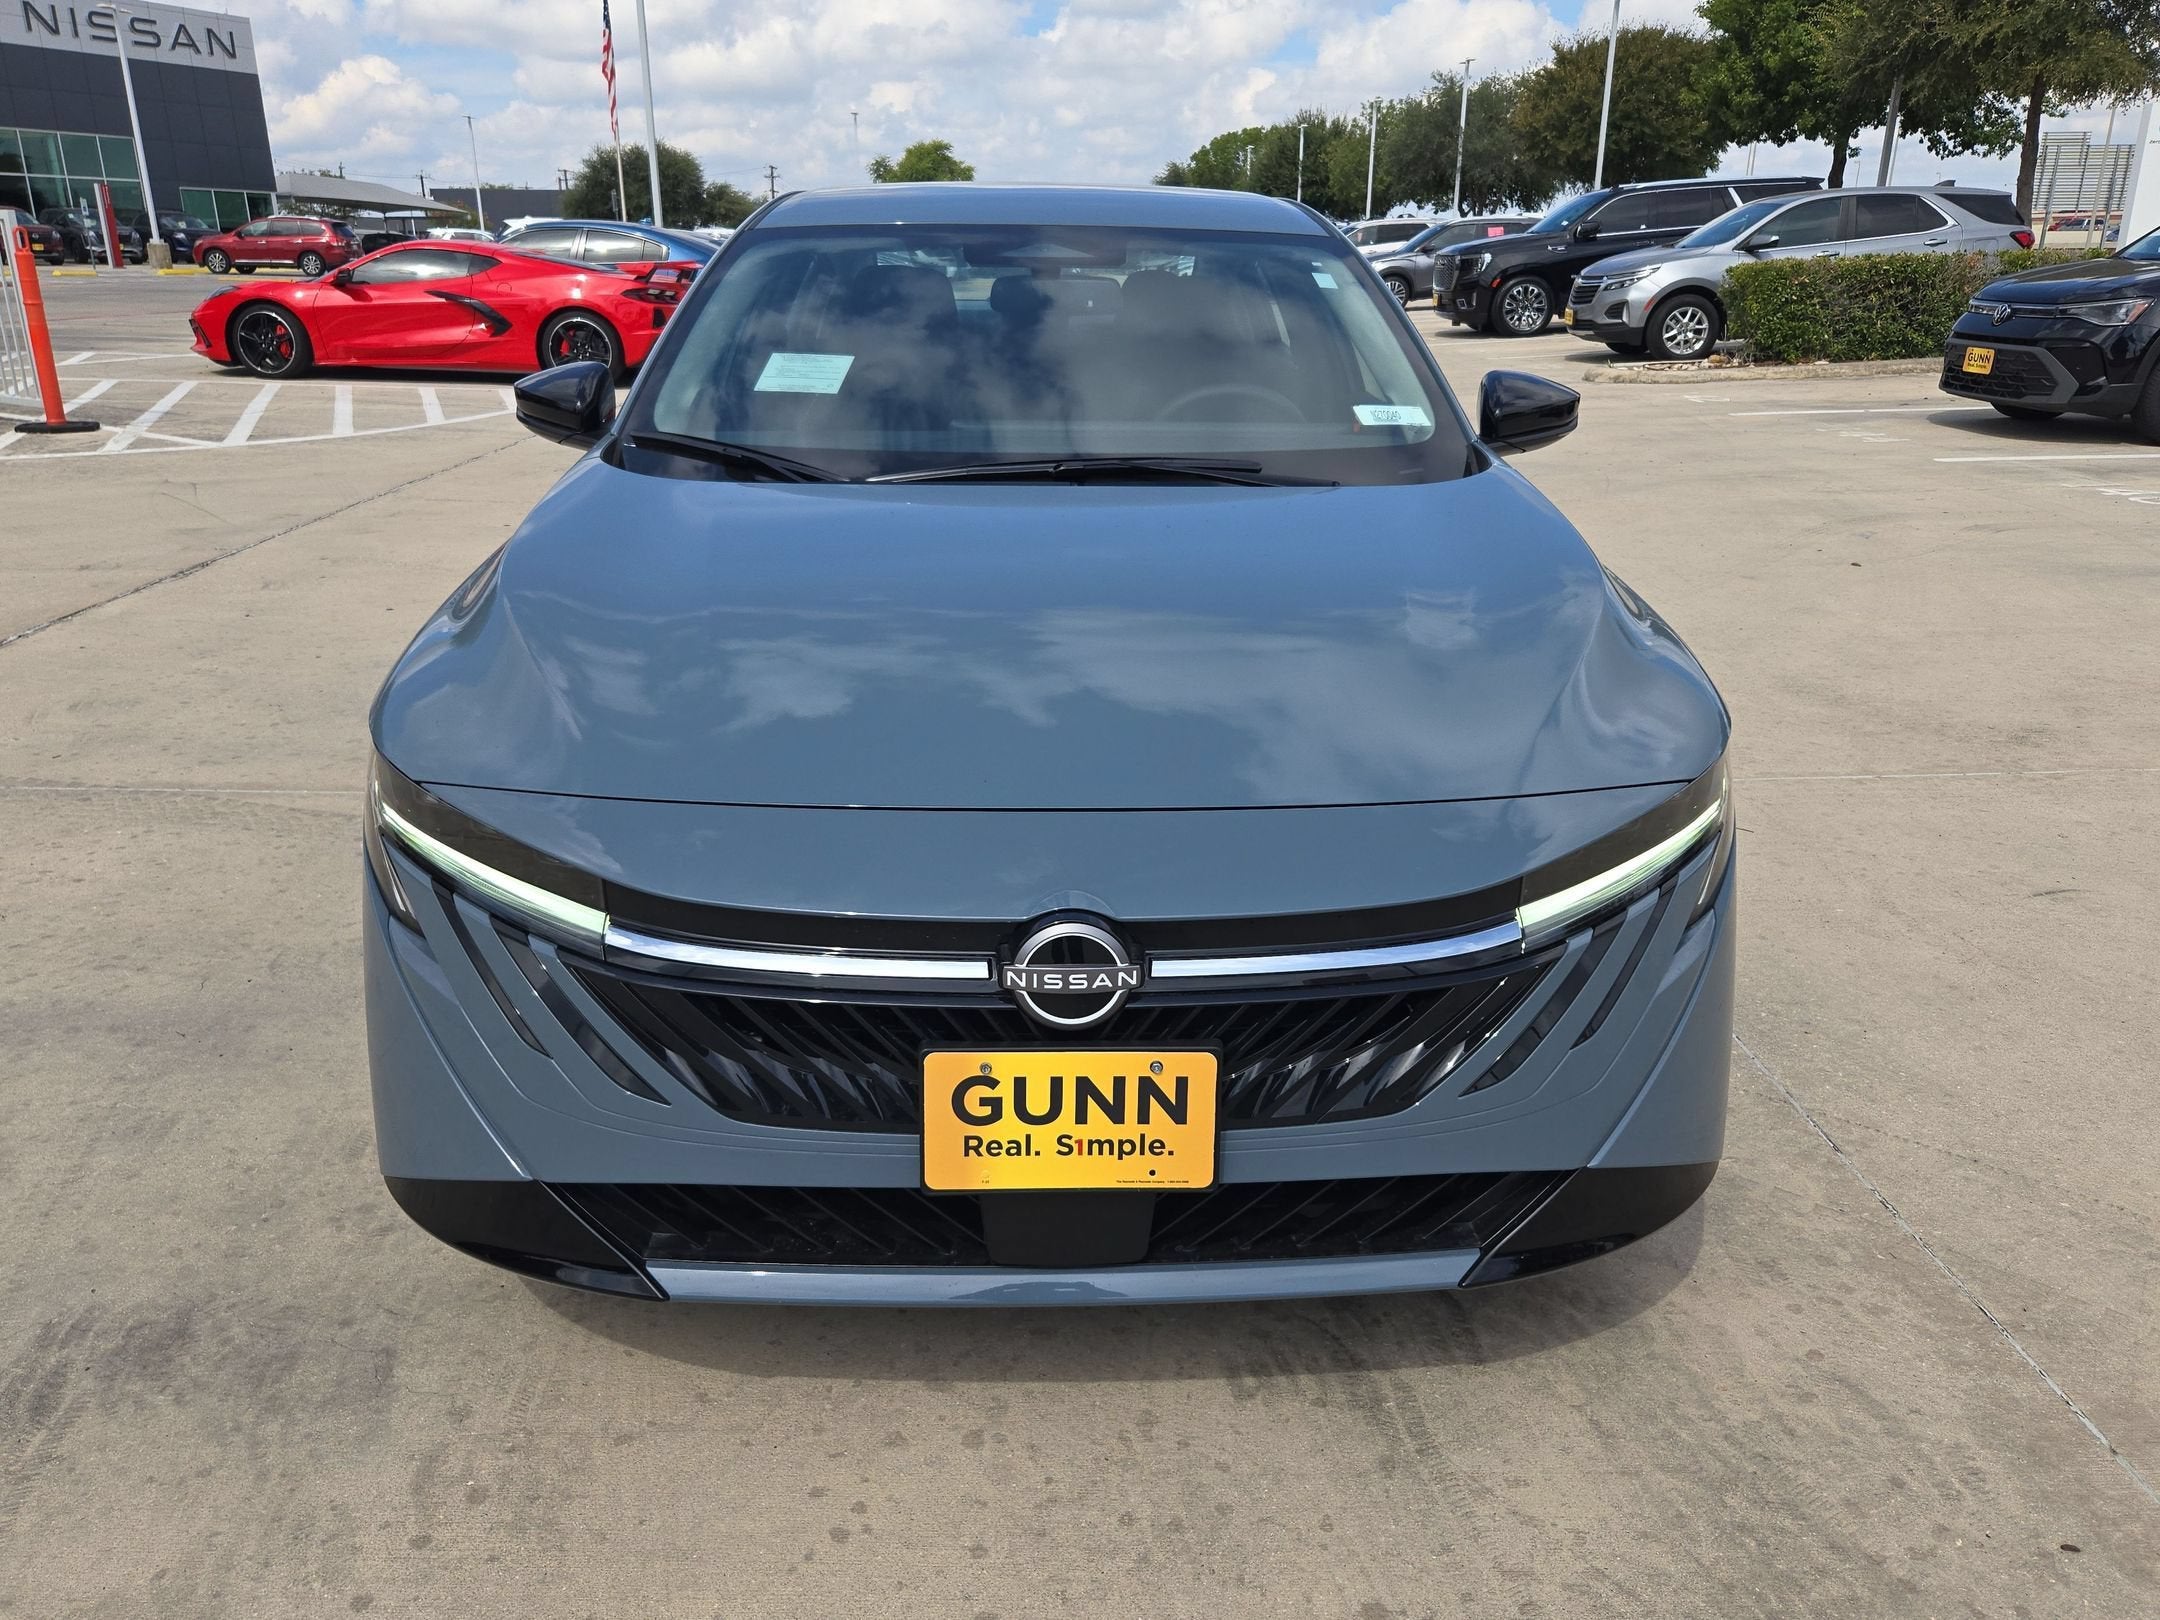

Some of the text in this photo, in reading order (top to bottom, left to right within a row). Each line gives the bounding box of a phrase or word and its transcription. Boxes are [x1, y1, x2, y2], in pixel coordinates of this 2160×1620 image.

[23, 1, 237, 59] NISSAN
[1968, 352, 1991, 364] GUNN
[1007, 970, 1136, 989] NISSAN
[952, 1075, 1188, 1126] GUNN
[964, 1133, 1041, 1157] Real.
